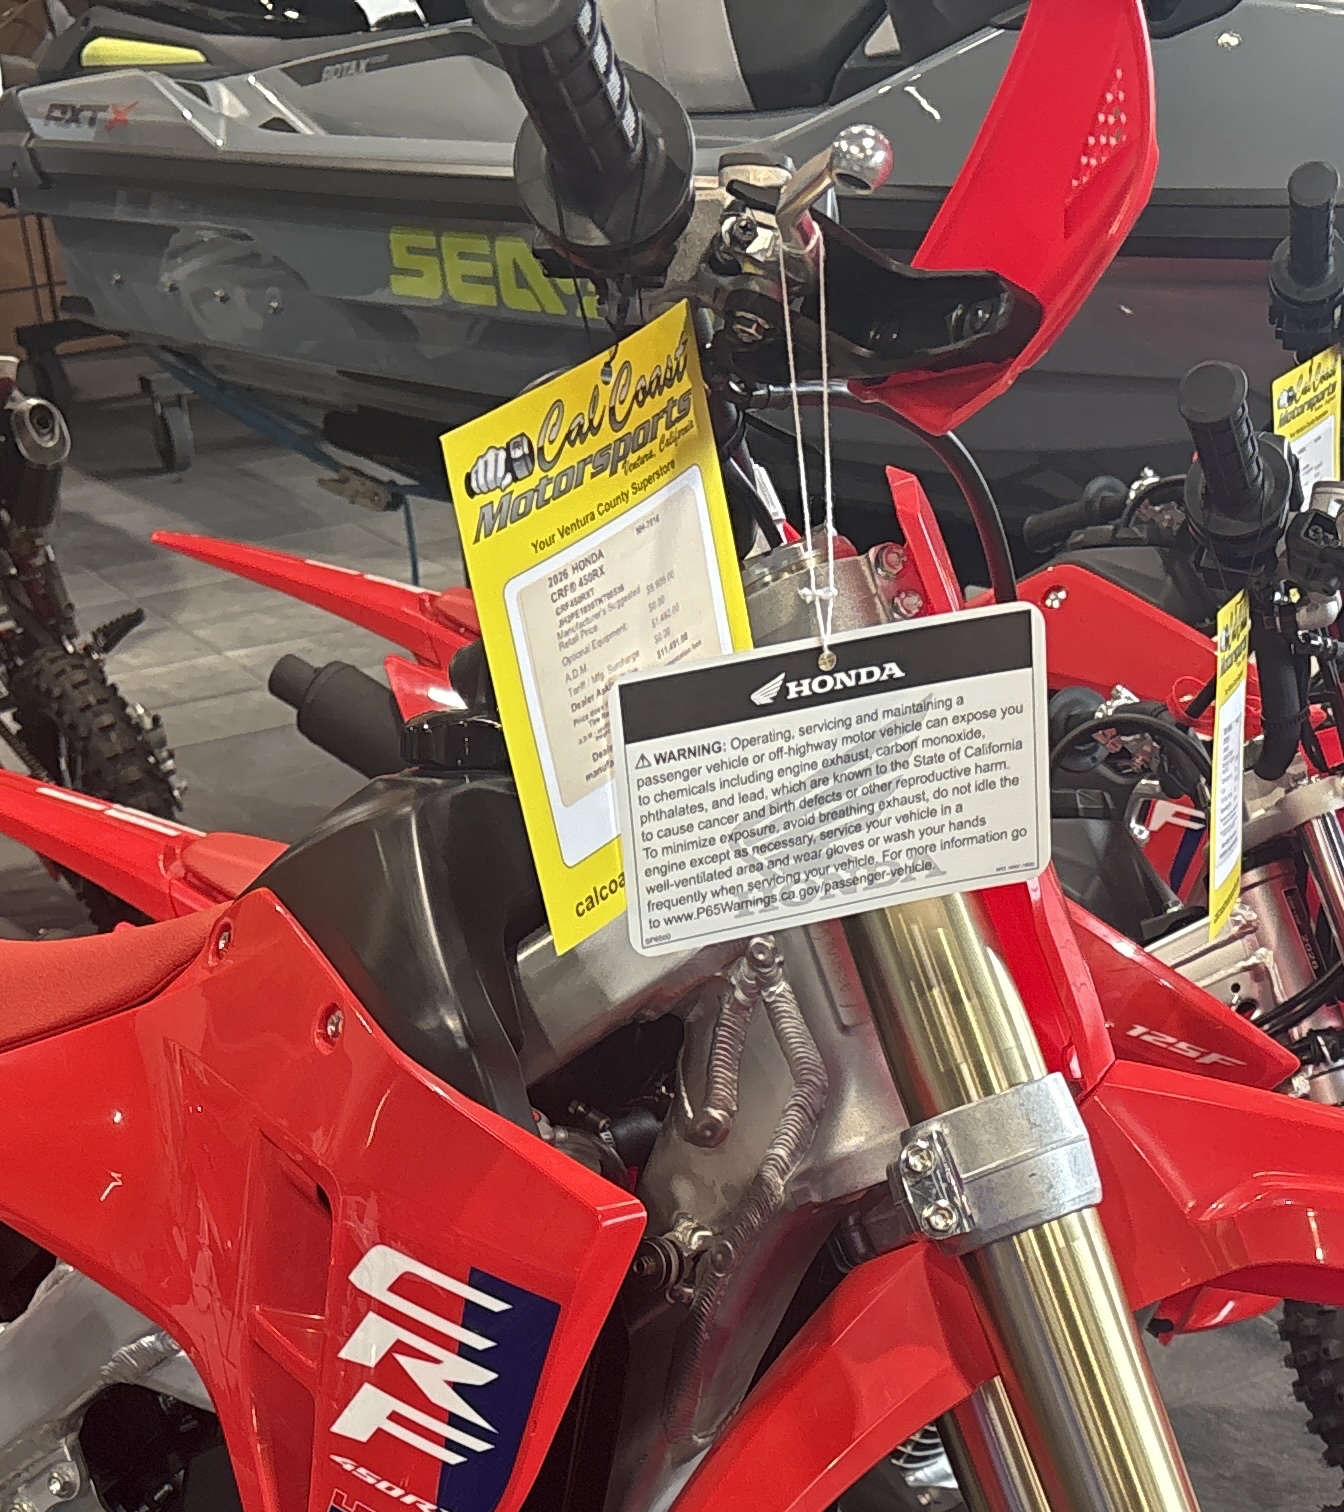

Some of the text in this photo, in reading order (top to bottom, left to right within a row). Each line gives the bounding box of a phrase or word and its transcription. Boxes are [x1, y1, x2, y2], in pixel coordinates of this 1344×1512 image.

[389, 226, 605, 319] SEA
[536, 330, 689, 472] Cal Coast
[472, 388, 693, 545] Motorsports
[531, 458, 676, 554] Your Ventura County Superstore
[548, 549, 605, 589] 2026 HONDA
[785, 661, 906, 700] HONDA
[636, 704, 1023, 790] passenger vehicle or off-highway motor vehicle can expose you
[638, 728, 984, 806] to chemicals including engine exhaust, carbon monoxide,
[653, 695, 963, 765] WARNING: Operating, servicing and maintaining a
[640, 739, 1022, 827] phthalates, and lead, which are known to the State of California
[641, 830, 653, 842] to
[656, 823, 693, 838] cause
[697, 813, 739, 830] cancer
[743, 805, 765, 821] and
[768, 800, 795, 815] birth
[799, 791, 841, 808] defects
[845, 788, 857, 798] or
[861, 780, 892, 795] other
[896, 766, 970, 789] reproductive
[642, 776, 1018, 859] To minimize exposure, avoid breathing exhaust, do not idle the
[644, 803, 962, 877] engine except as necessary, service your vehicle in a
[645, 815, 985, 894] well-ventilated area and wear gloves or wash your hands
[647, 828, 1026, 912] frequently when servicing your vehicle. For more information go
[648, 918, 660, 929] to
[1125, 1023, 1249, 1067] 125F
[329, 1244, 514, 1466] CRF
